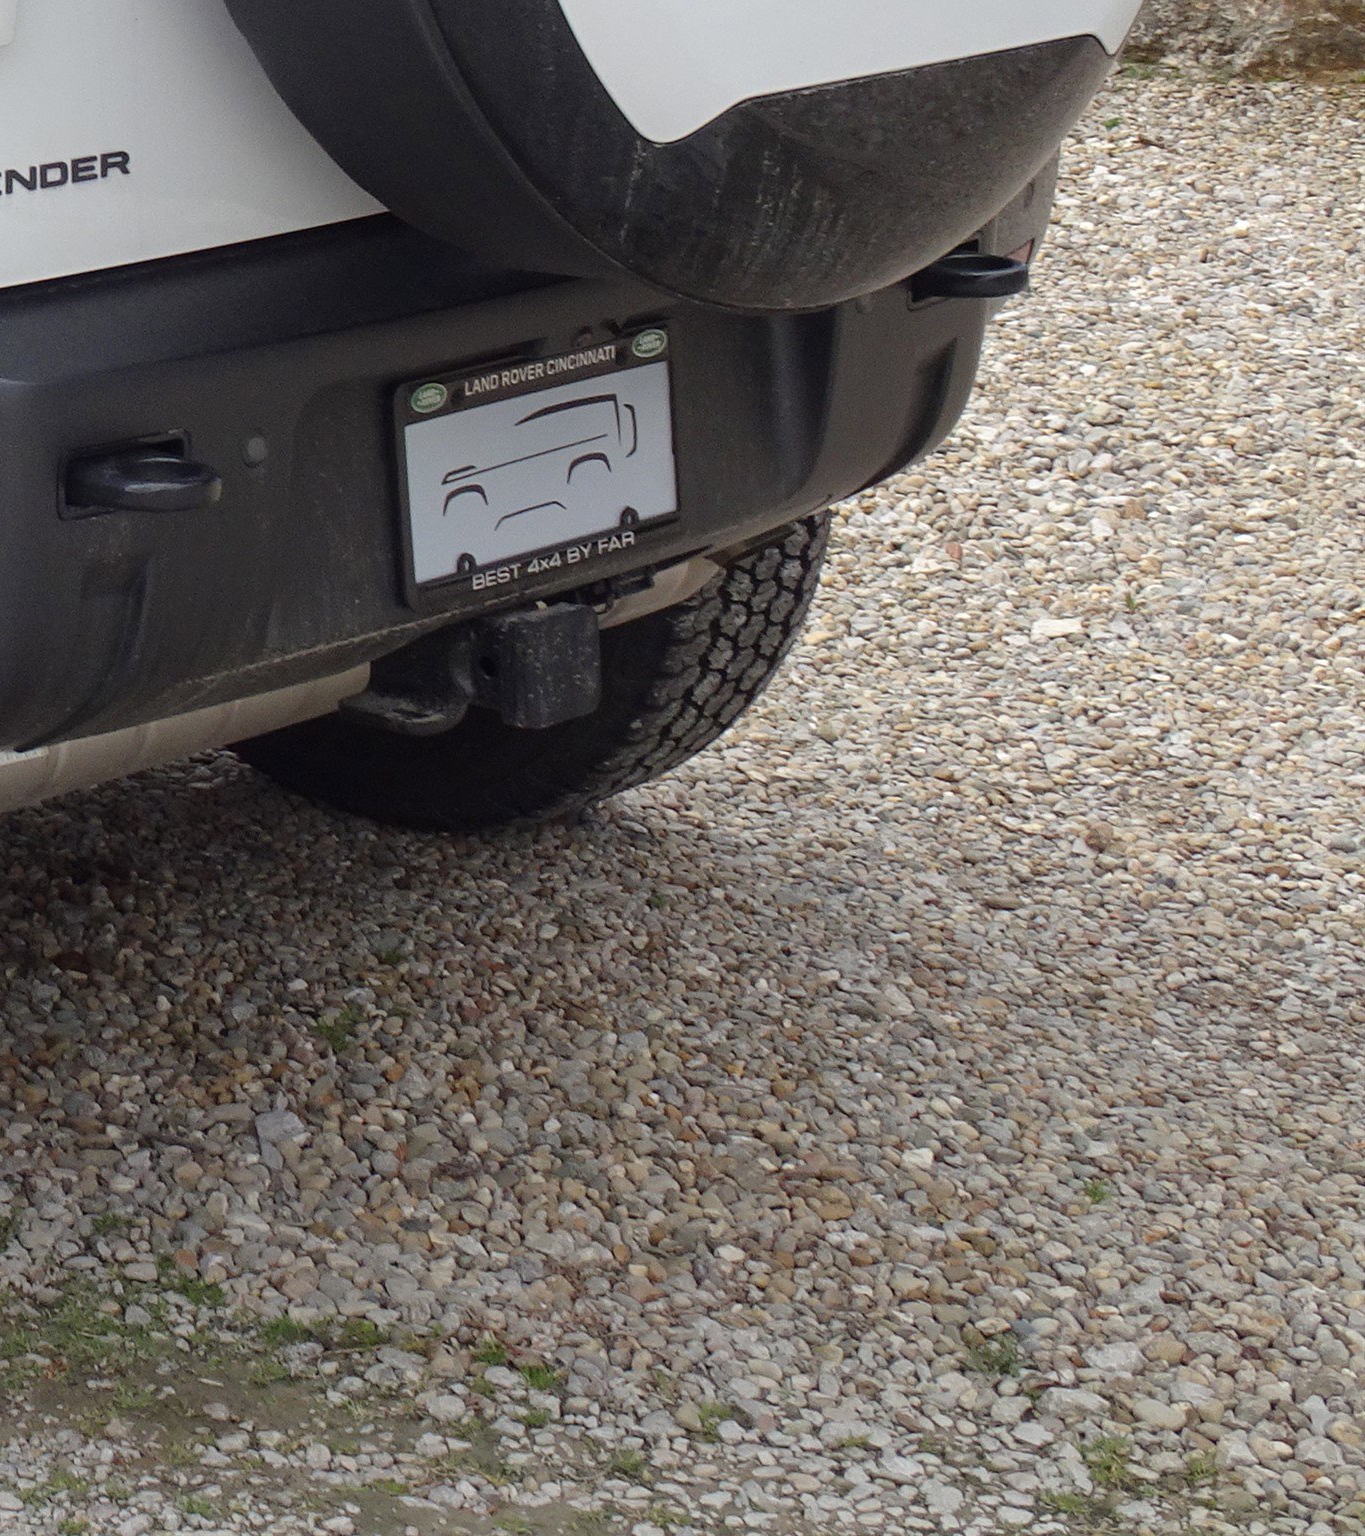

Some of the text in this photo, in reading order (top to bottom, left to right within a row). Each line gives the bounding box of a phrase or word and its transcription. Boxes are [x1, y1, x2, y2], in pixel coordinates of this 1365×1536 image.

[464, 345, 616, 396] LAND ROVER CINCINNATI
[472, 531, 635, 590] BEST 4x4 BY FAR
